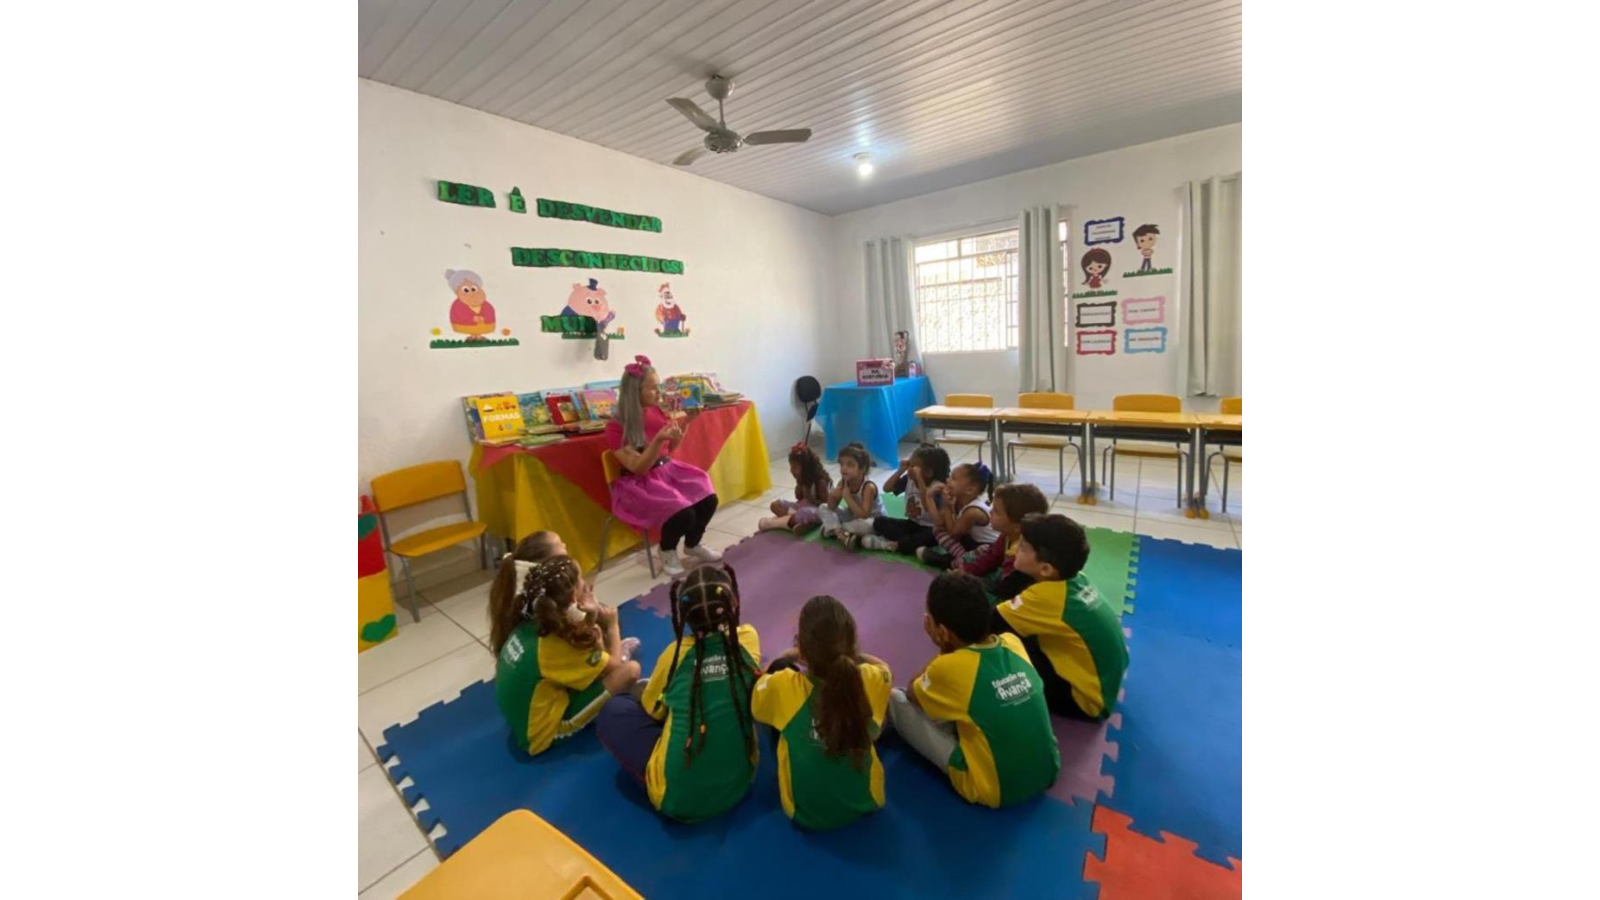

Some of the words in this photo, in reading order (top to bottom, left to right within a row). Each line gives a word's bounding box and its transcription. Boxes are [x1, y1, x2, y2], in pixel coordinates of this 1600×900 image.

[438, 180, 496, 208] LER
[537, 198, 663, 233] DESVENDAR
[541, 315, 597, 333] MUN
[482, 411, 521, 423] FORMAS
[997, 678, 1032, 700] Avança
